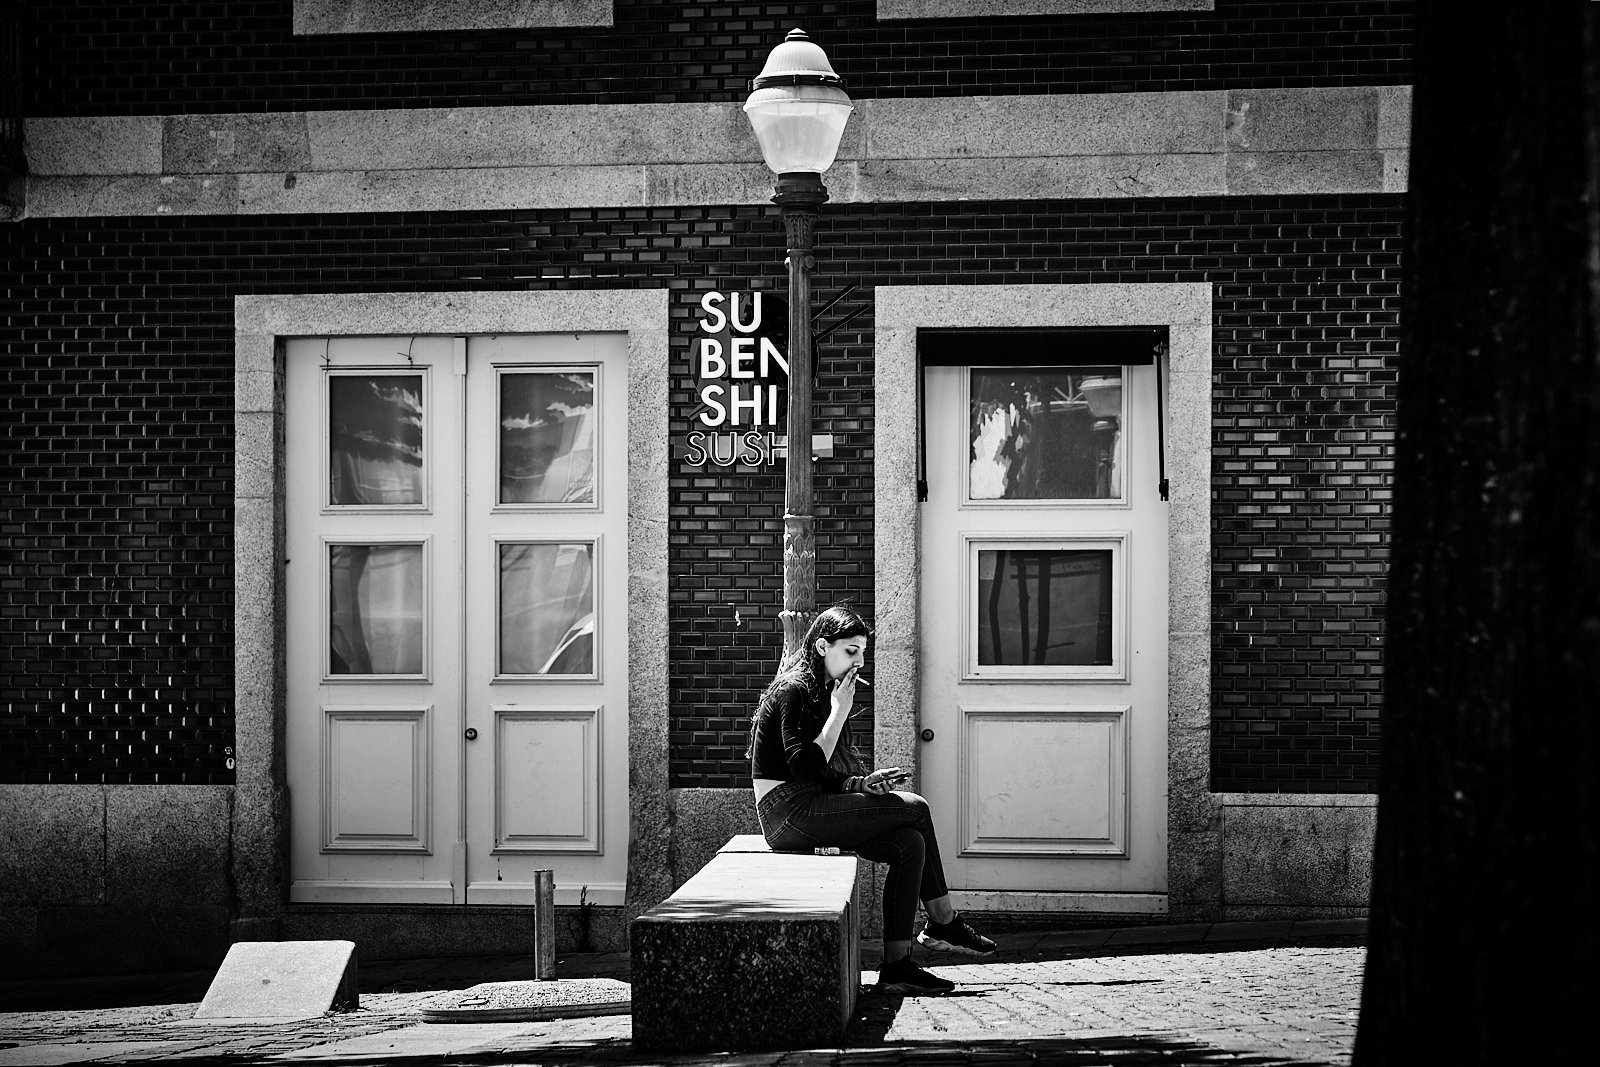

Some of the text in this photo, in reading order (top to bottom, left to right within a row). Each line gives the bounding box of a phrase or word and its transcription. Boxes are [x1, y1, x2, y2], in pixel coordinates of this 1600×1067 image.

[699, 291, 762, 333] SU
[700, 337, 789, 379] BEN
[699, 384, 777, 427] SHI
[684, 431, 788, 466] SUSH
